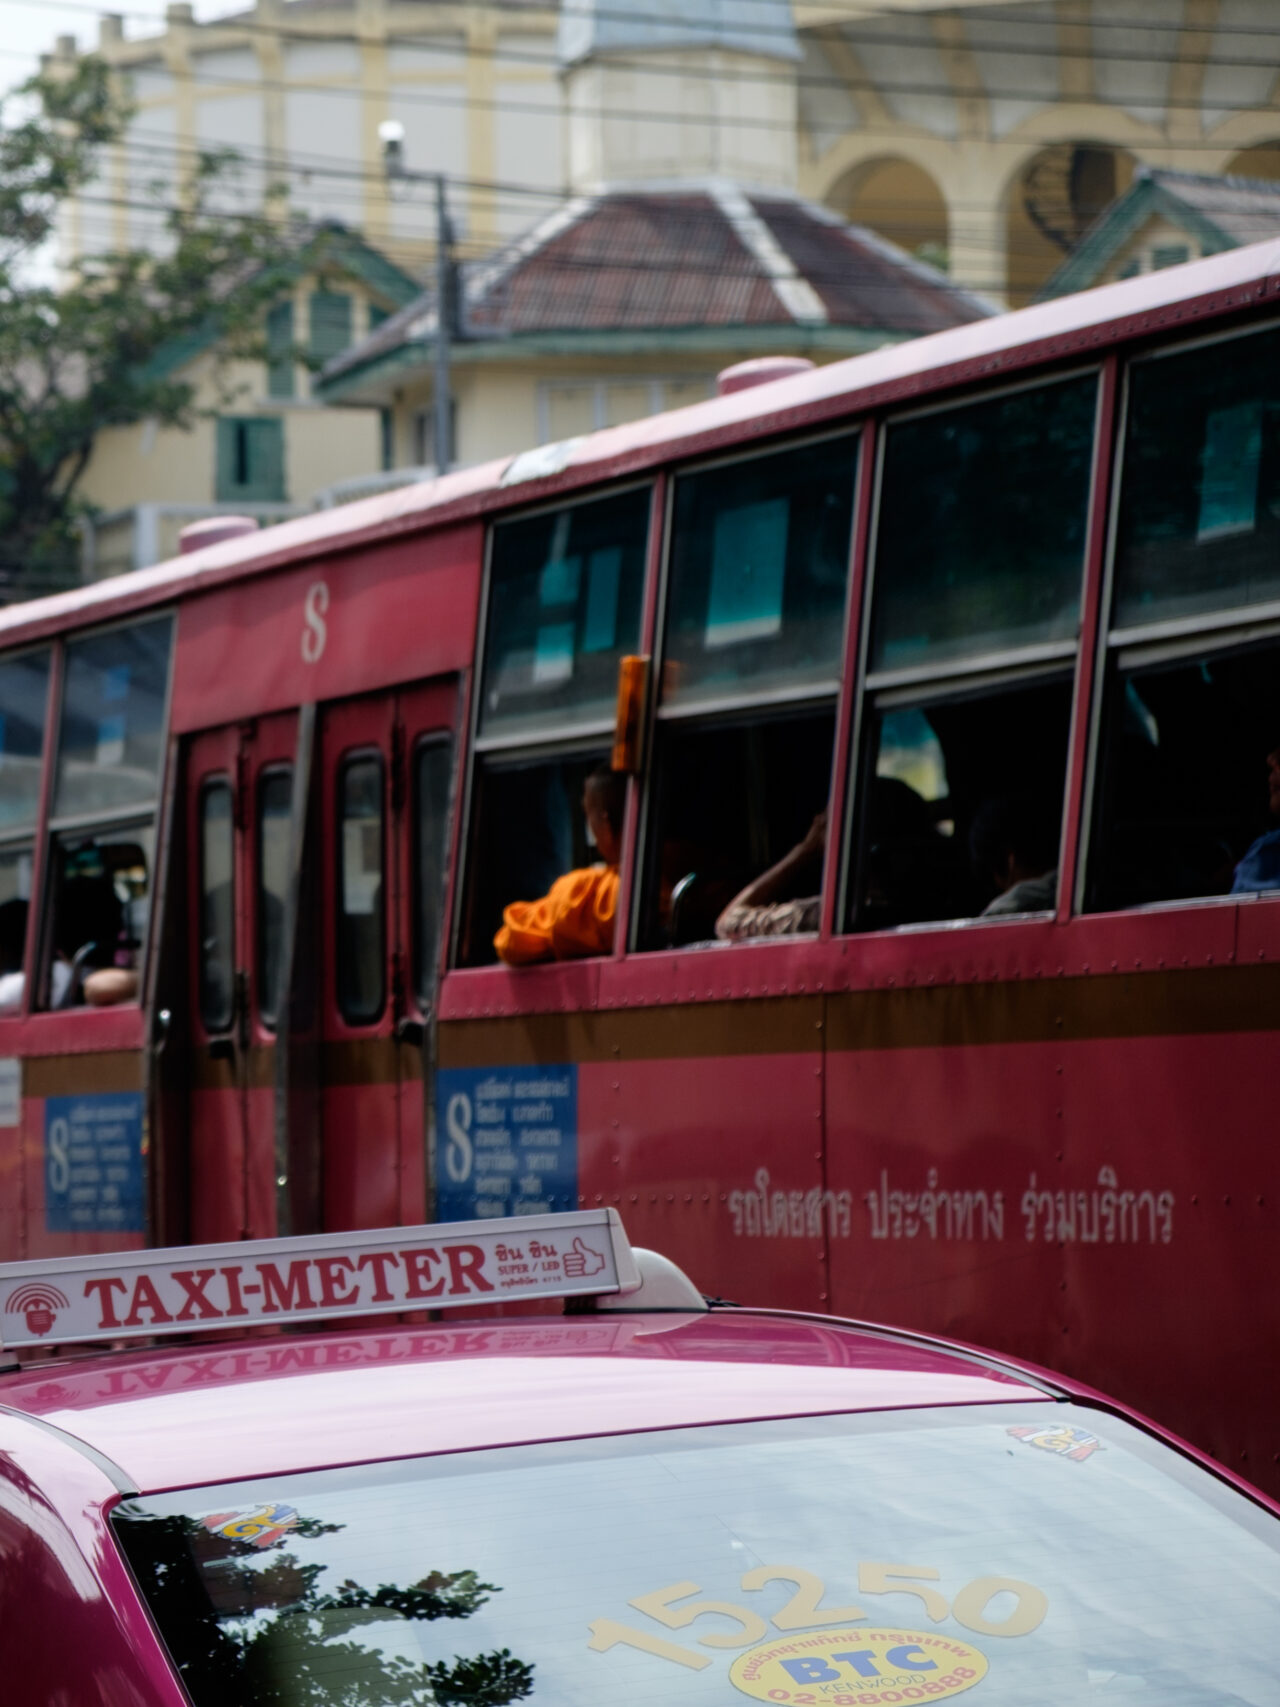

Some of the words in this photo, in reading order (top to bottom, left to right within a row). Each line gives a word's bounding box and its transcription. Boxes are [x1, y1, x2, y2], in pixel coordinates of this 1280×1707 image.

[301, 581, 330, 664] 8
[49, 1117, 69, 1194] 8
[446, 1093, 472, 1183] 8
[728, 1167, 852, 1238] รถโดยสาร
[868, 1168, 1004, 1240] ประจำทาง
[1022, 1166, 1175, 1243] ร่วมบริการ
[84, 1243, 495, 1329] TAXI-METER
[498, 1264, 529, 1275] SUPER
[542, 1260, 560, 1271] LED
[587, 1561, 1049, 1671] 15250
[768, 1666, 977, 1706] 02-8800888
[778, 1644, 938, 1686] BTC
[818, 1674, 926, 1694] KENWOOD
